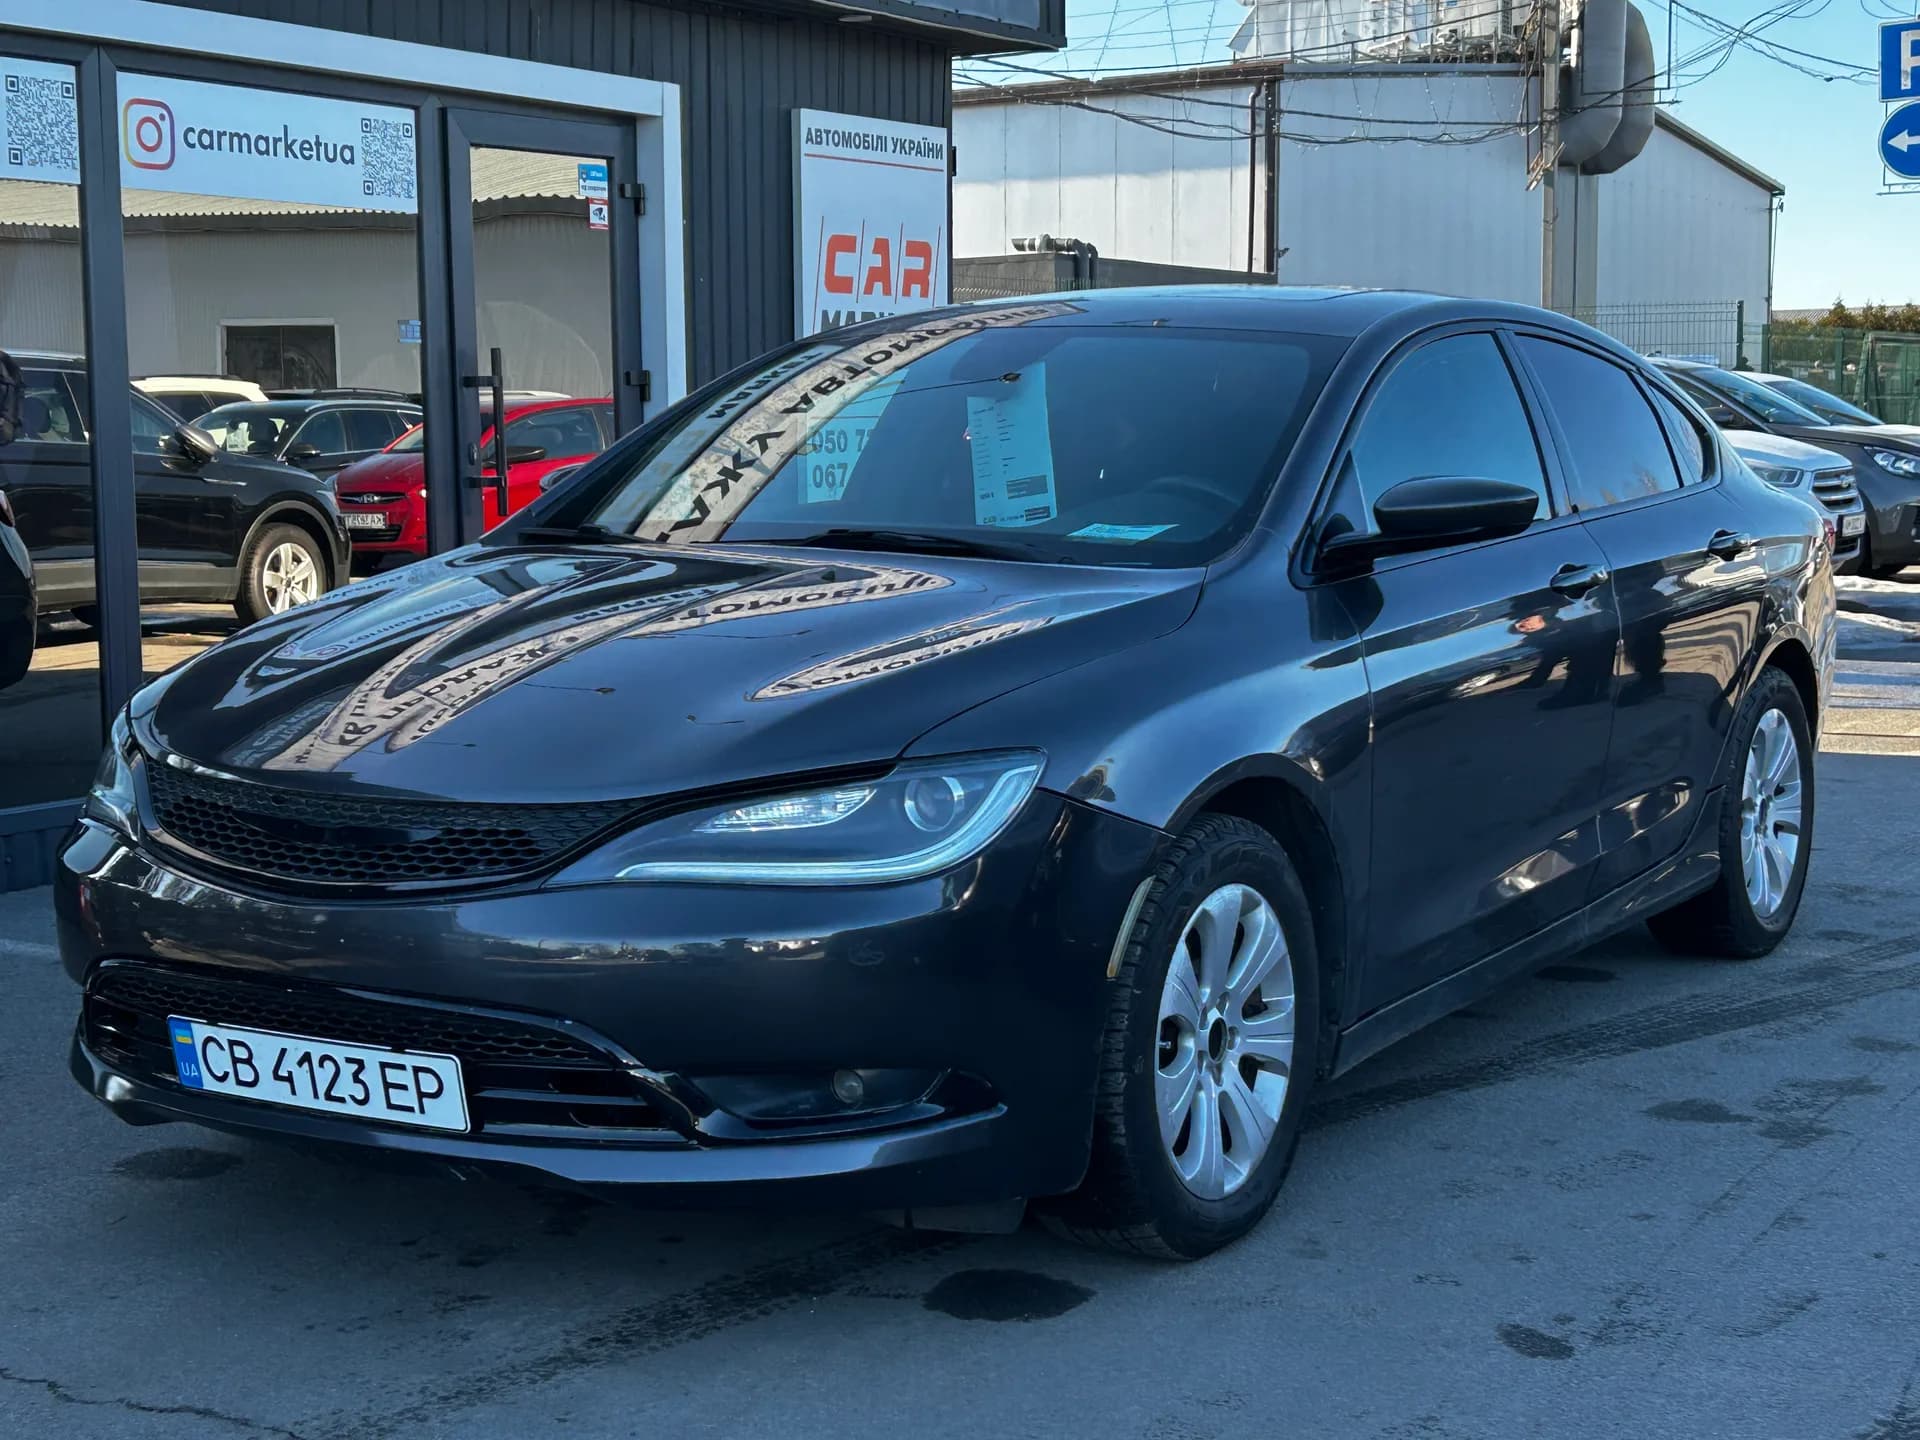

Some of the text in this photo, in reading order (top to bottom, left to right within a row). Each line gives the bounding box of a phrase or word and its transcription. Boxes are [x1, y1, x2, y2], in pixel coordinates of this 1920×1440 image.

[183, 124, 355, 165] carmarketua
[805, 127, 944, 160] АВТОМОБІЛІ УКРАЇНИ
[824, 234, 932, 298] CAR
[812, 463, 848, 488] 067
[181, 1061, 199, 1078] UA
[201, 1035, 444, 1114] CB 4123 EP
